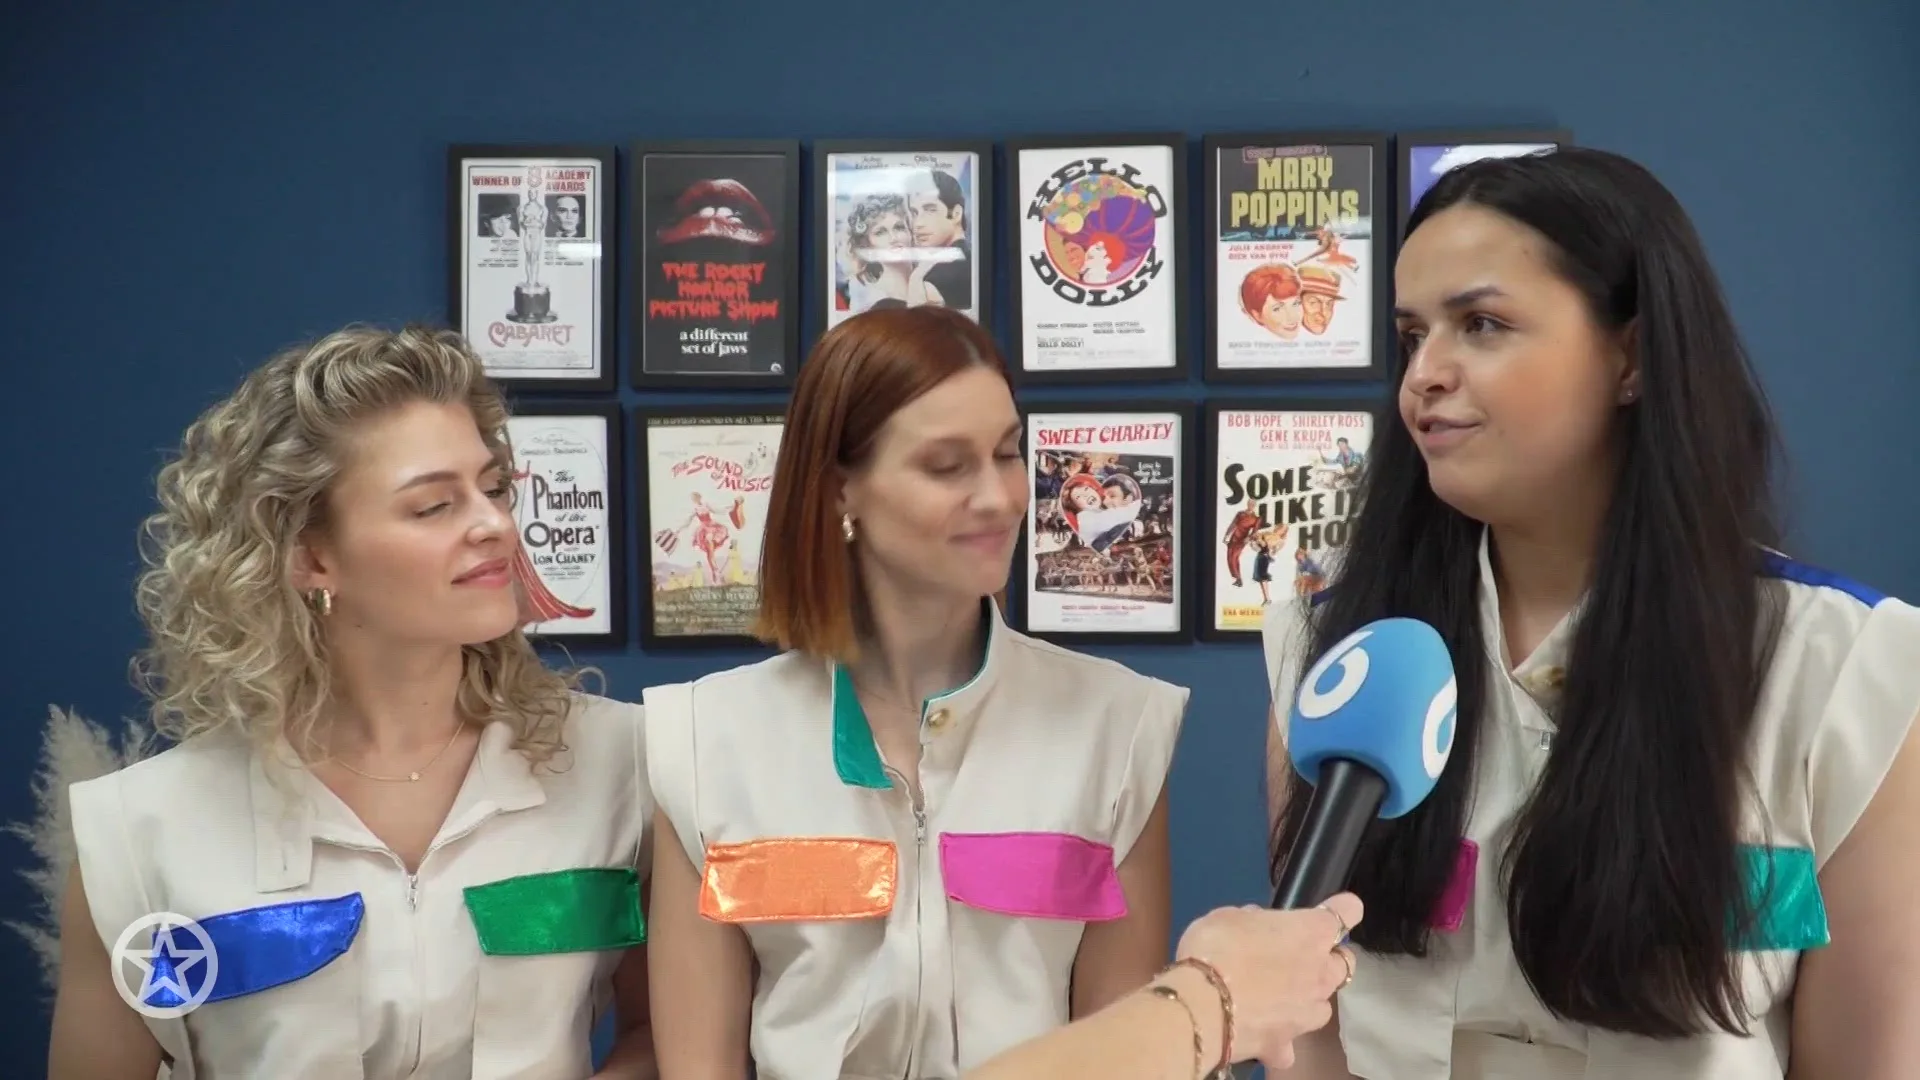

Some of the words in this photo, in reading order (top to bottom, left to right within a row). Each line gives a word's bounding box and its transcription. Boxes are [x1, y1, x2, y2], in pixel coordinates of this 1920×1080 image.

[472, 175, 510, 186] WINNER
[511, 175, 523, 185] OF
[545, 170, 591, 180] ACADEMY
[1257, 156, 1333, 190] MARY
[545, 181, 586, 192] AWARDS
[1026, 157, 1167, 222] HELLO
[1231, 189, 1359, 228] POPPINS
[662, 262, 699, 282] THE
[705, 262, 766, 283] ROCKY
[1029, 244, 1164, 307] DOLLY
[678, 280, 750, 300] HORROR
[649, 300, 721, 319] PICTURE
[726, 299, 779, 324] SHOW
[679, 331, 688, 341] a
[689, 328, 749, 341] different
[681, 343, 701, 354] set
[701, 341, 716, 354] of
[718, 342, 748, 357] jaws
[1227, 414, 1253, 428] BOB
[1254, 414, 1282, 427] HOPE
[1292, 414, 1336, 427] SHIRLEY
[1337, 414, 1365, 427] ROSS
[1037, 427, 1097, 446] SWEET
[1099, 421, 1174, 443] CHARITY
[1260, 430, 1288, 442] GENE
[1293, 429, 1333, 442] KRUPA
[687, 455, 743, 476] SOUND
[1224, 462, 1314, 506] SOME
[531, 473, 604, 519] Phantom
[1258, 493, 1325, 528] LIKE
[1298, 520, 1348, 550] HO
[533, 552, 553, 565] LON
[1298, 631, 1374, 719] 6
